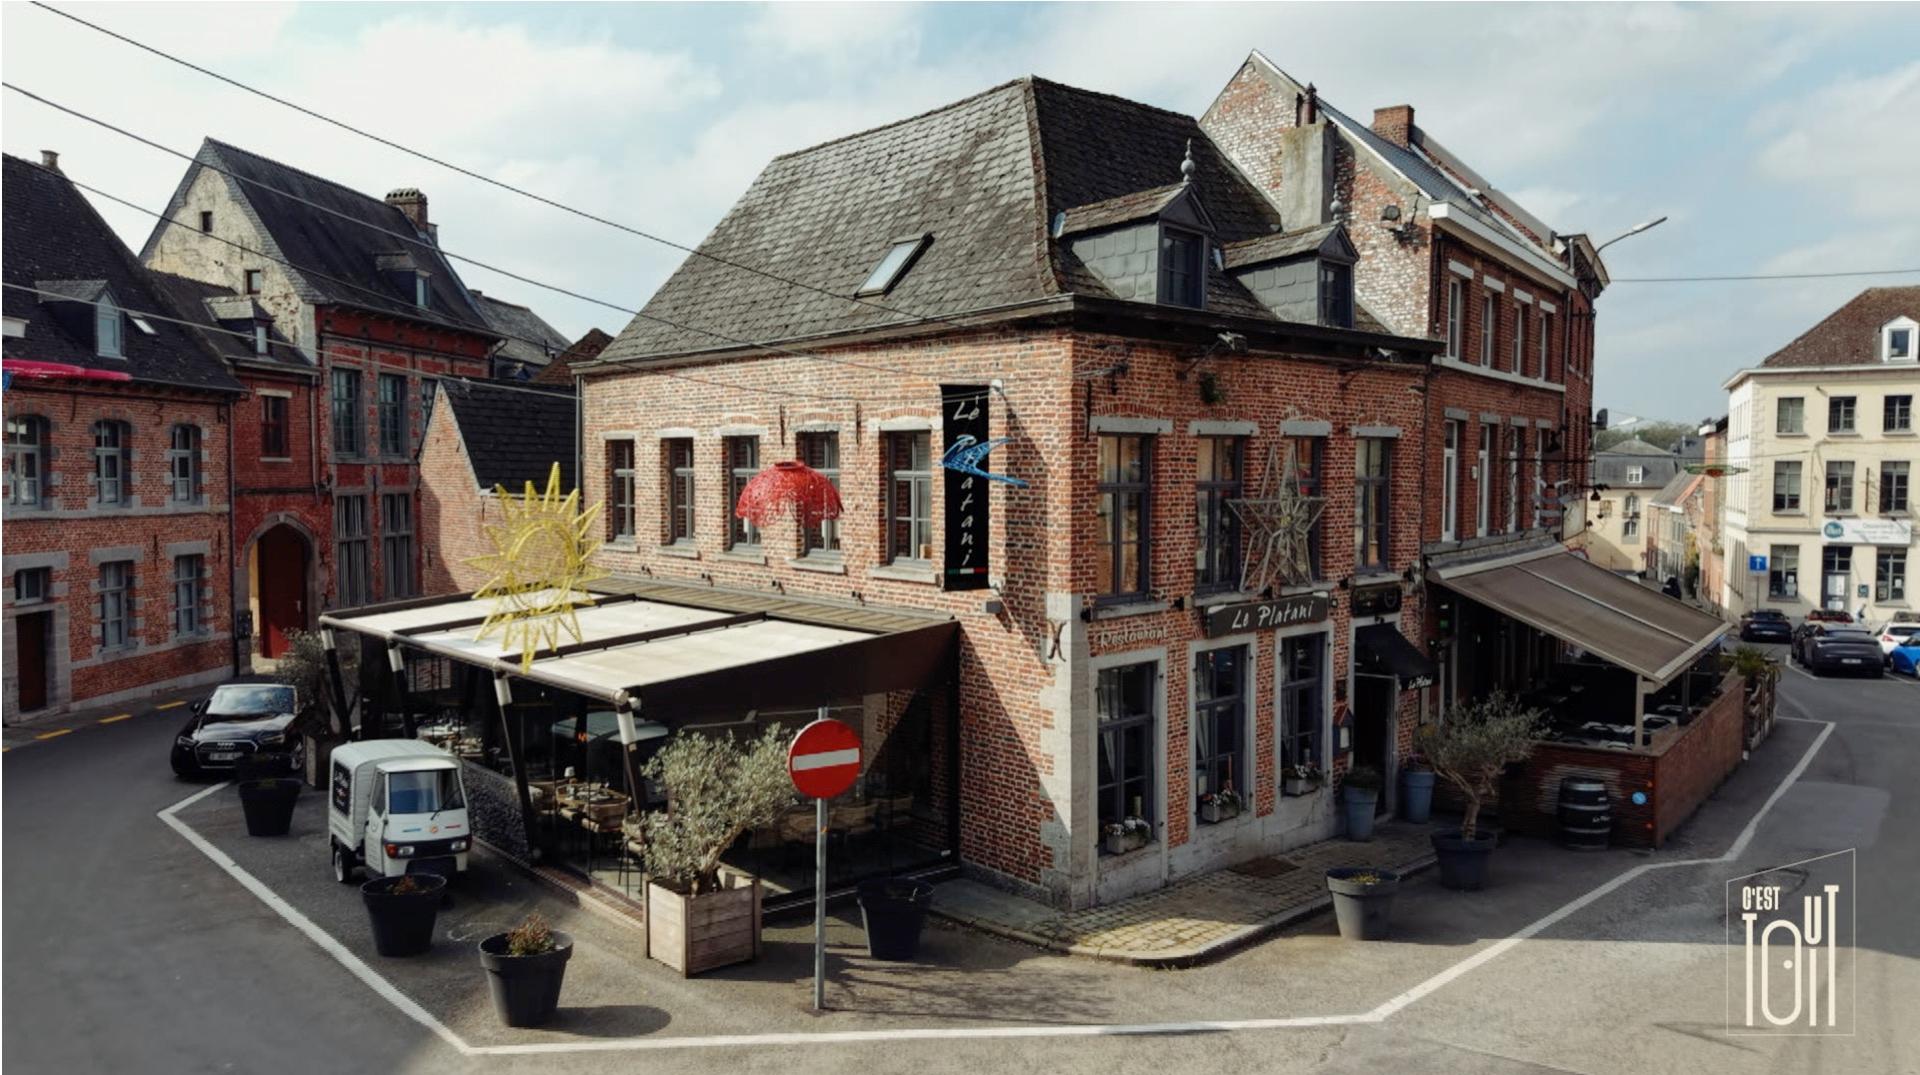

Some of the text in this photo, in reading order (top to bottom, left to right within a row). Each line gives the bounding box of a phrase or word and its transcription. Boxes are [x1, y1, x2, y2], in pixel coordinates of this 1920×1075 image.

[1231, 600, 1314, 630] Le Platani
[1093, 625, 1168, 648] Restaurant
